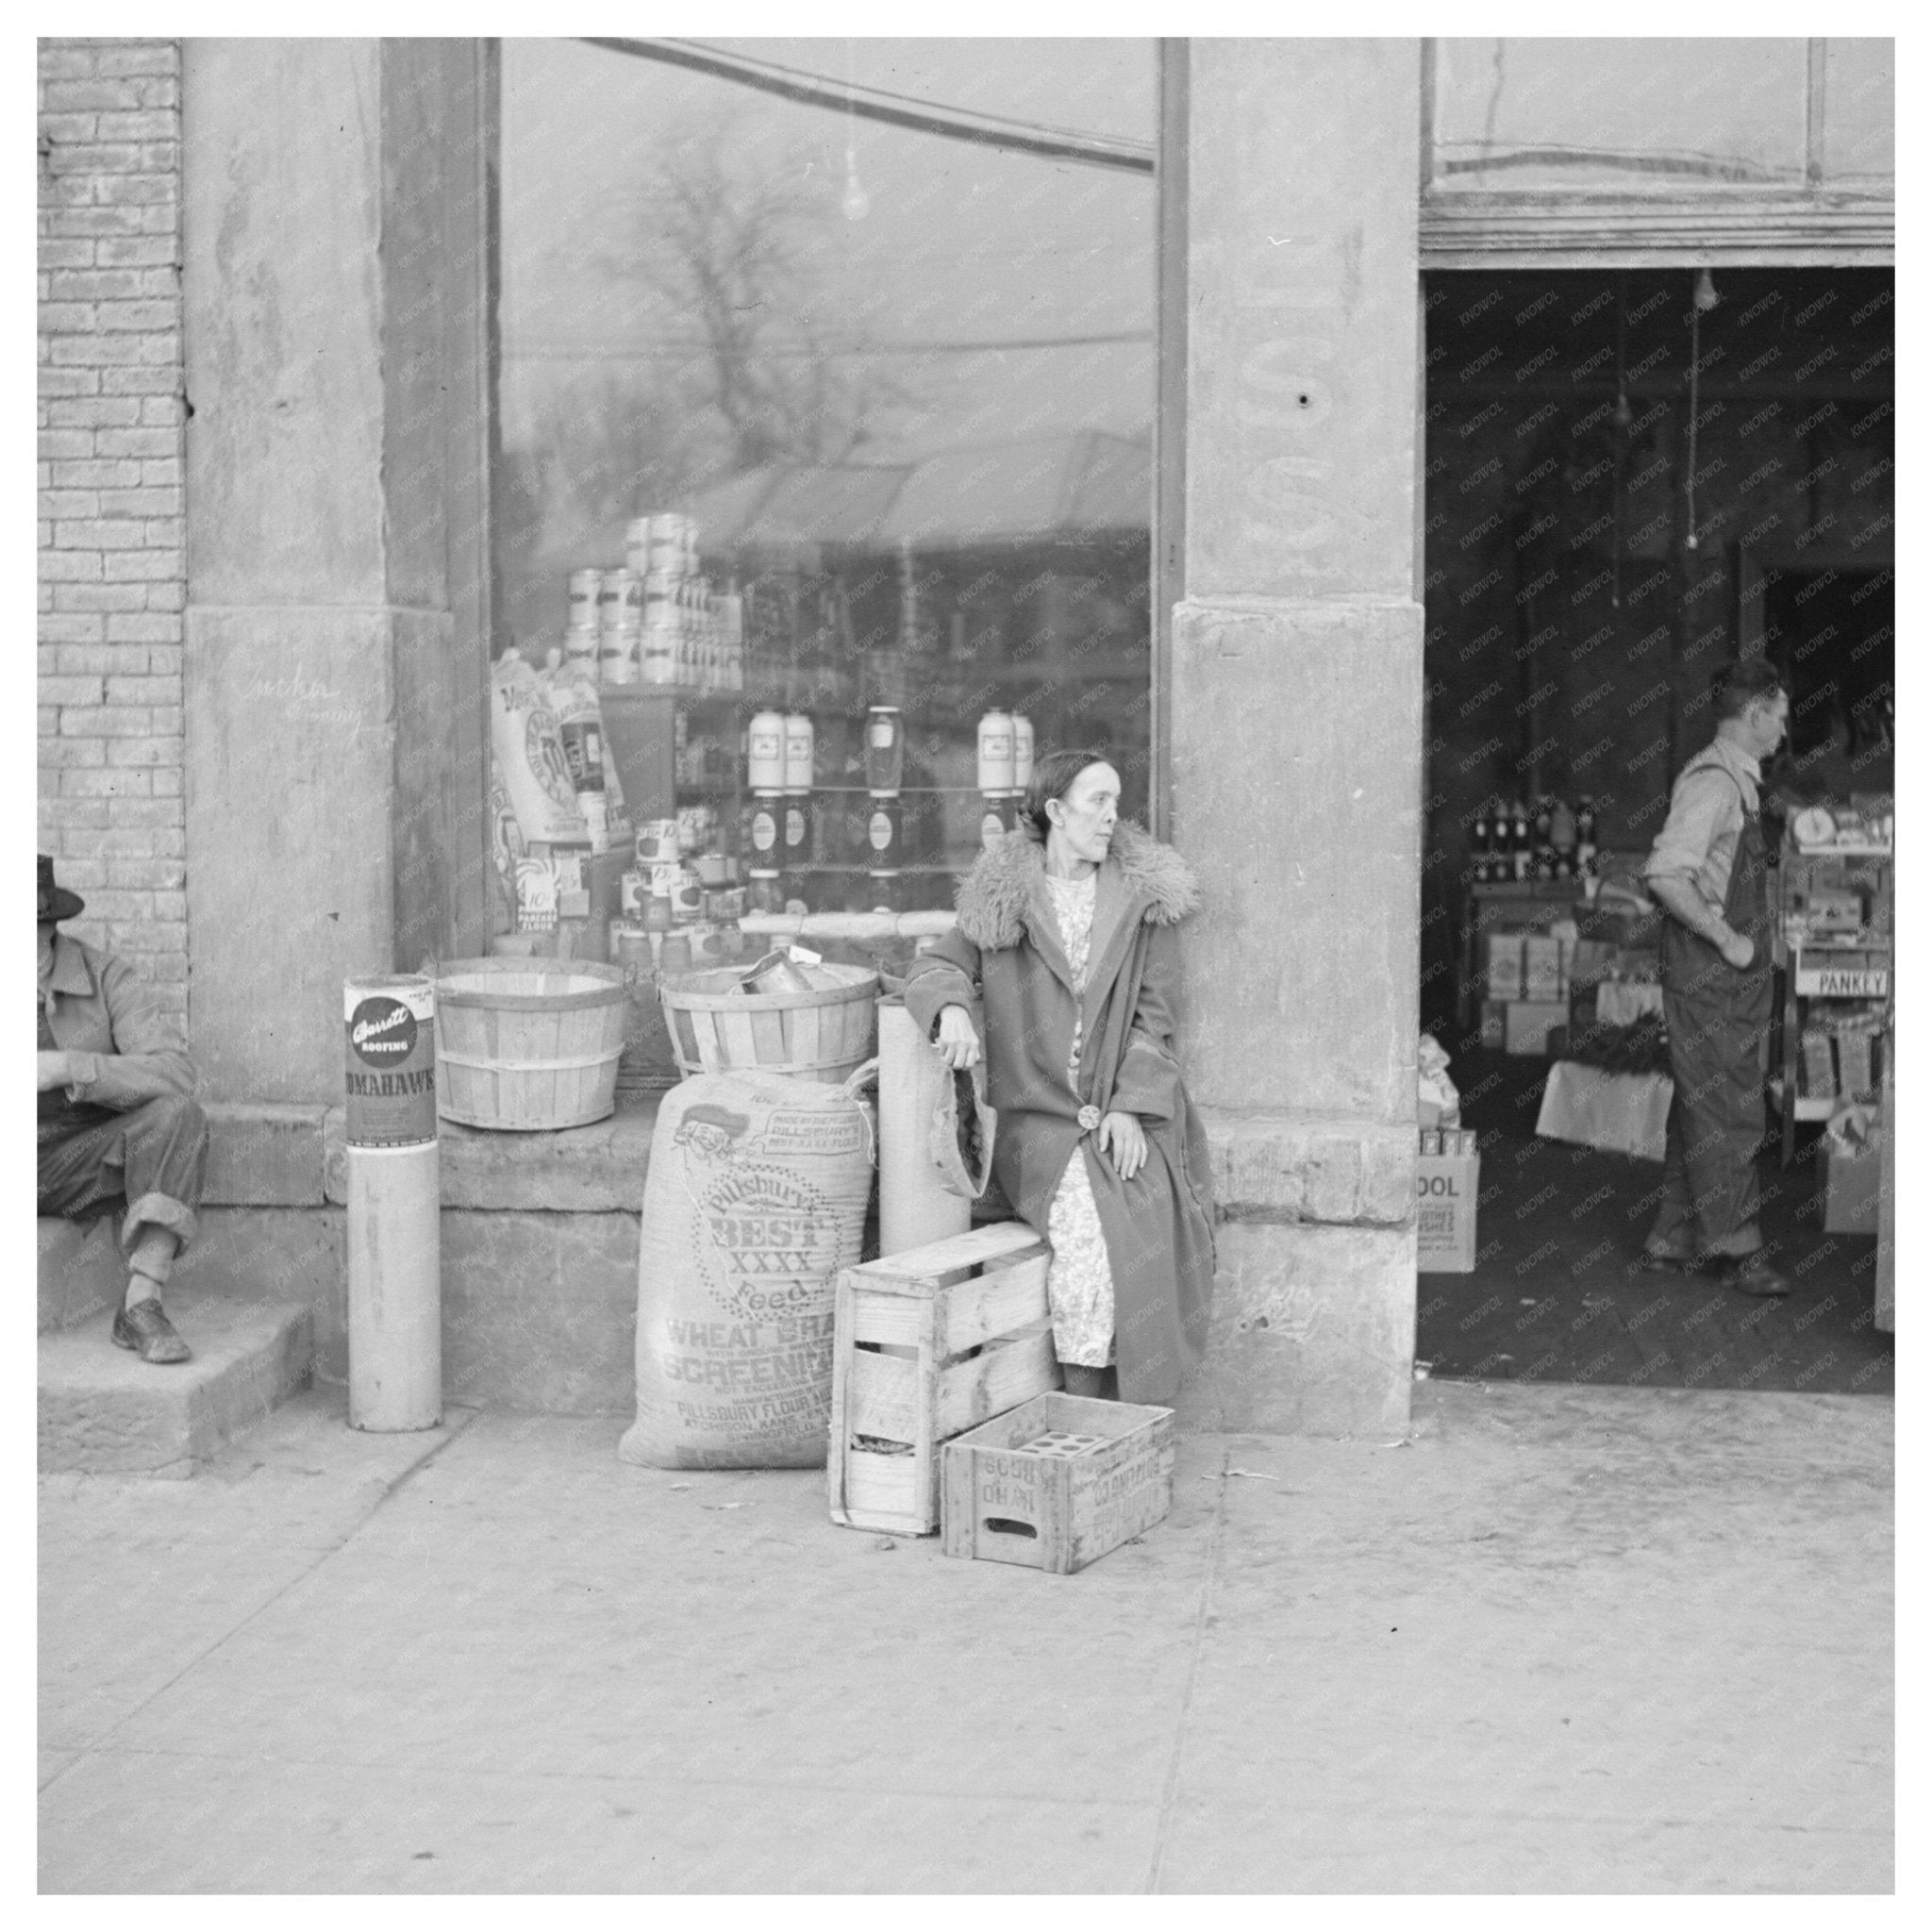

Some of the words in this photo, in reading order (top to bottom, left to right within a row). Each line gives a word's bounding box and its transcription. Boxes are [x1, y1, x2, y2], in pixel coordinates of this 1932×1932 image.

[353, 1006, 409, 1044] Barrett
[361, 1041, 408, 1052] ROOFING
[709, 1219, 824, 1247] BEST
[730, 1251, 812, 1274] XXXX
[730, 1279, 808, 1310] Feed
[667, 1320, 763, 1348] WHEAT
[677, 1401, 758, 1421] PILLSBURY
[762, 1396, 810, 1418] FLOUR
